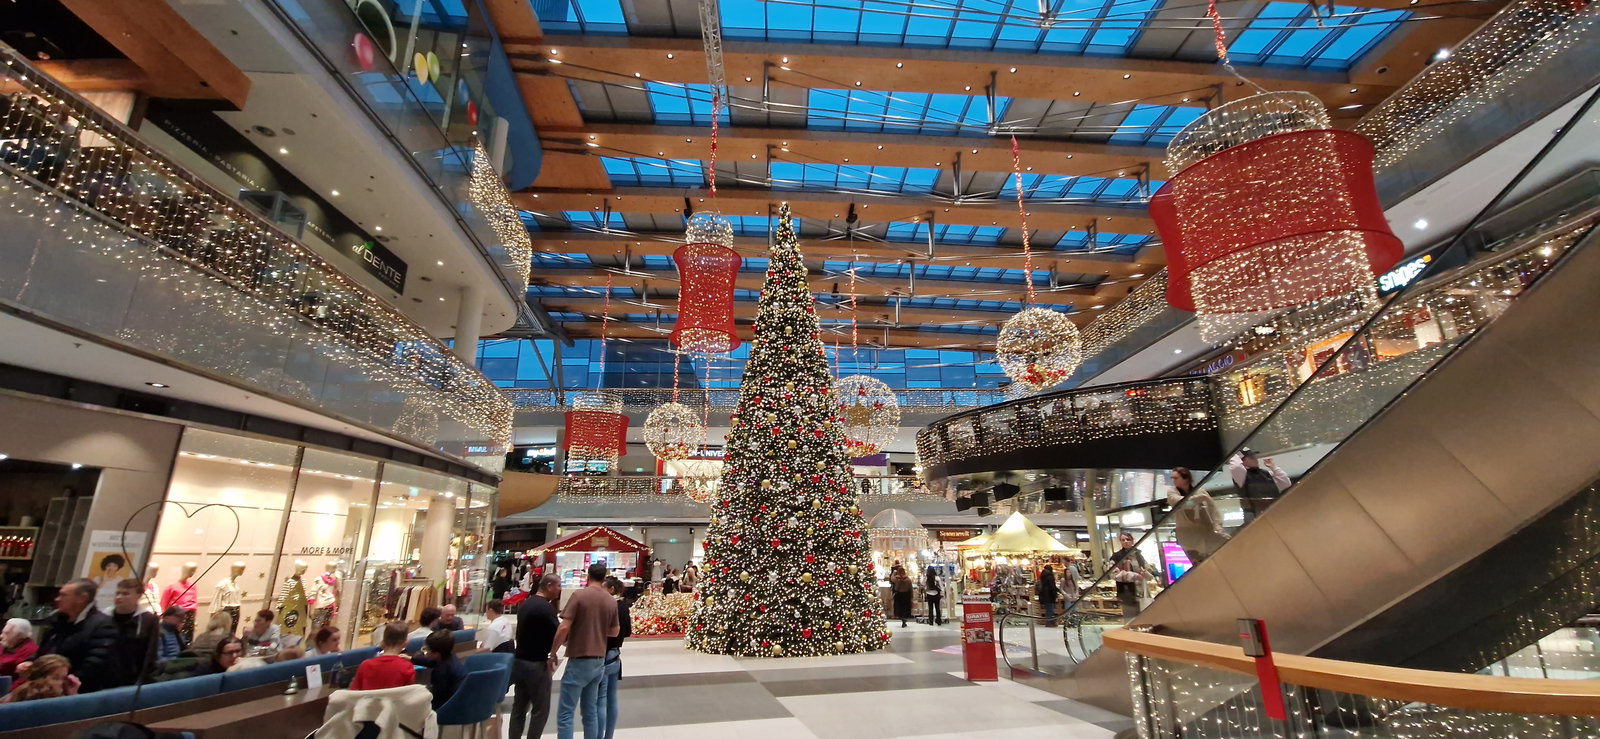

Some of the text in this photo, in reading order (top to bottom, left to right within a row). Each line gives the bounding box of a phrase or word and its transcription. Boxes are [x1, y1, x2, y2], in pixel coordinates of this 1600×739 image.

[163, 118, 208, 153] PIZZERIA
[214, 154, 255, 186] PASTARIA
[351, 243, 365, 256] al
[363, 249, 402, 285] DENTE
[1379, 258, 1427, 291] snipes
[300, 546, 325, 555] MORE
[332, 547, 354, 555] MORE
